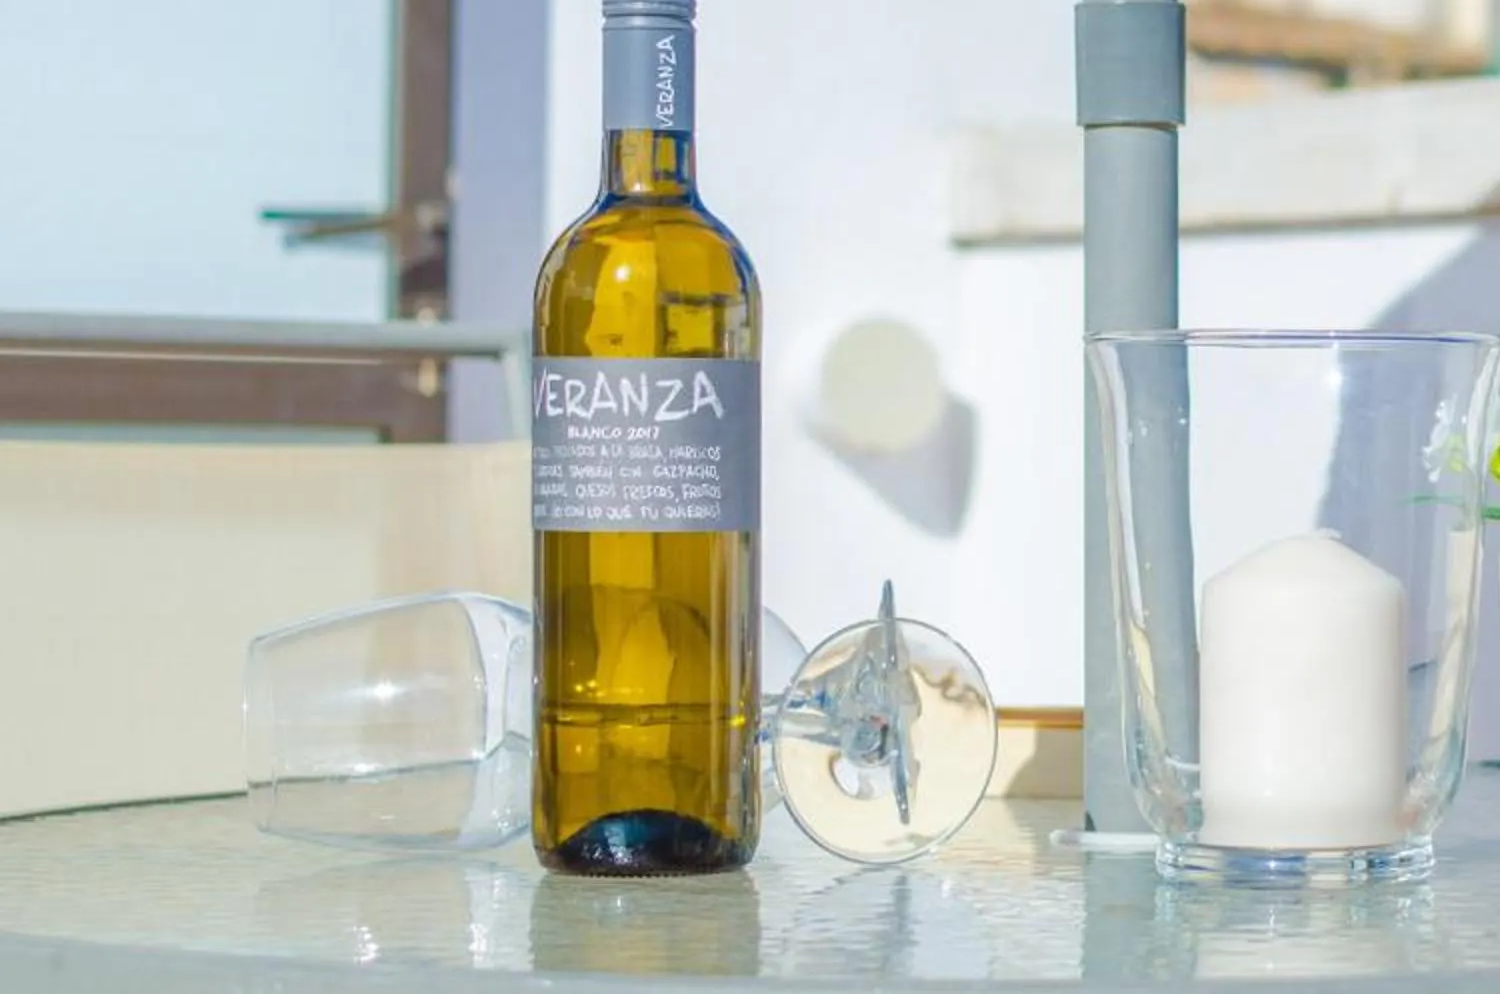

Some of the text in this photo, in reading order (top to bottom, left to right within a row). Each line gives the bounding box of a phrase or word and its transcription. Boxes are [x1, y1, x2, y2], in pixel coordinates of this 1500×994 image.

[655, 34, 676, 128] VERANZA
[533, 367, 725, 422] VERANZA
[567, 425, 661, 440] BLANCO 2017
